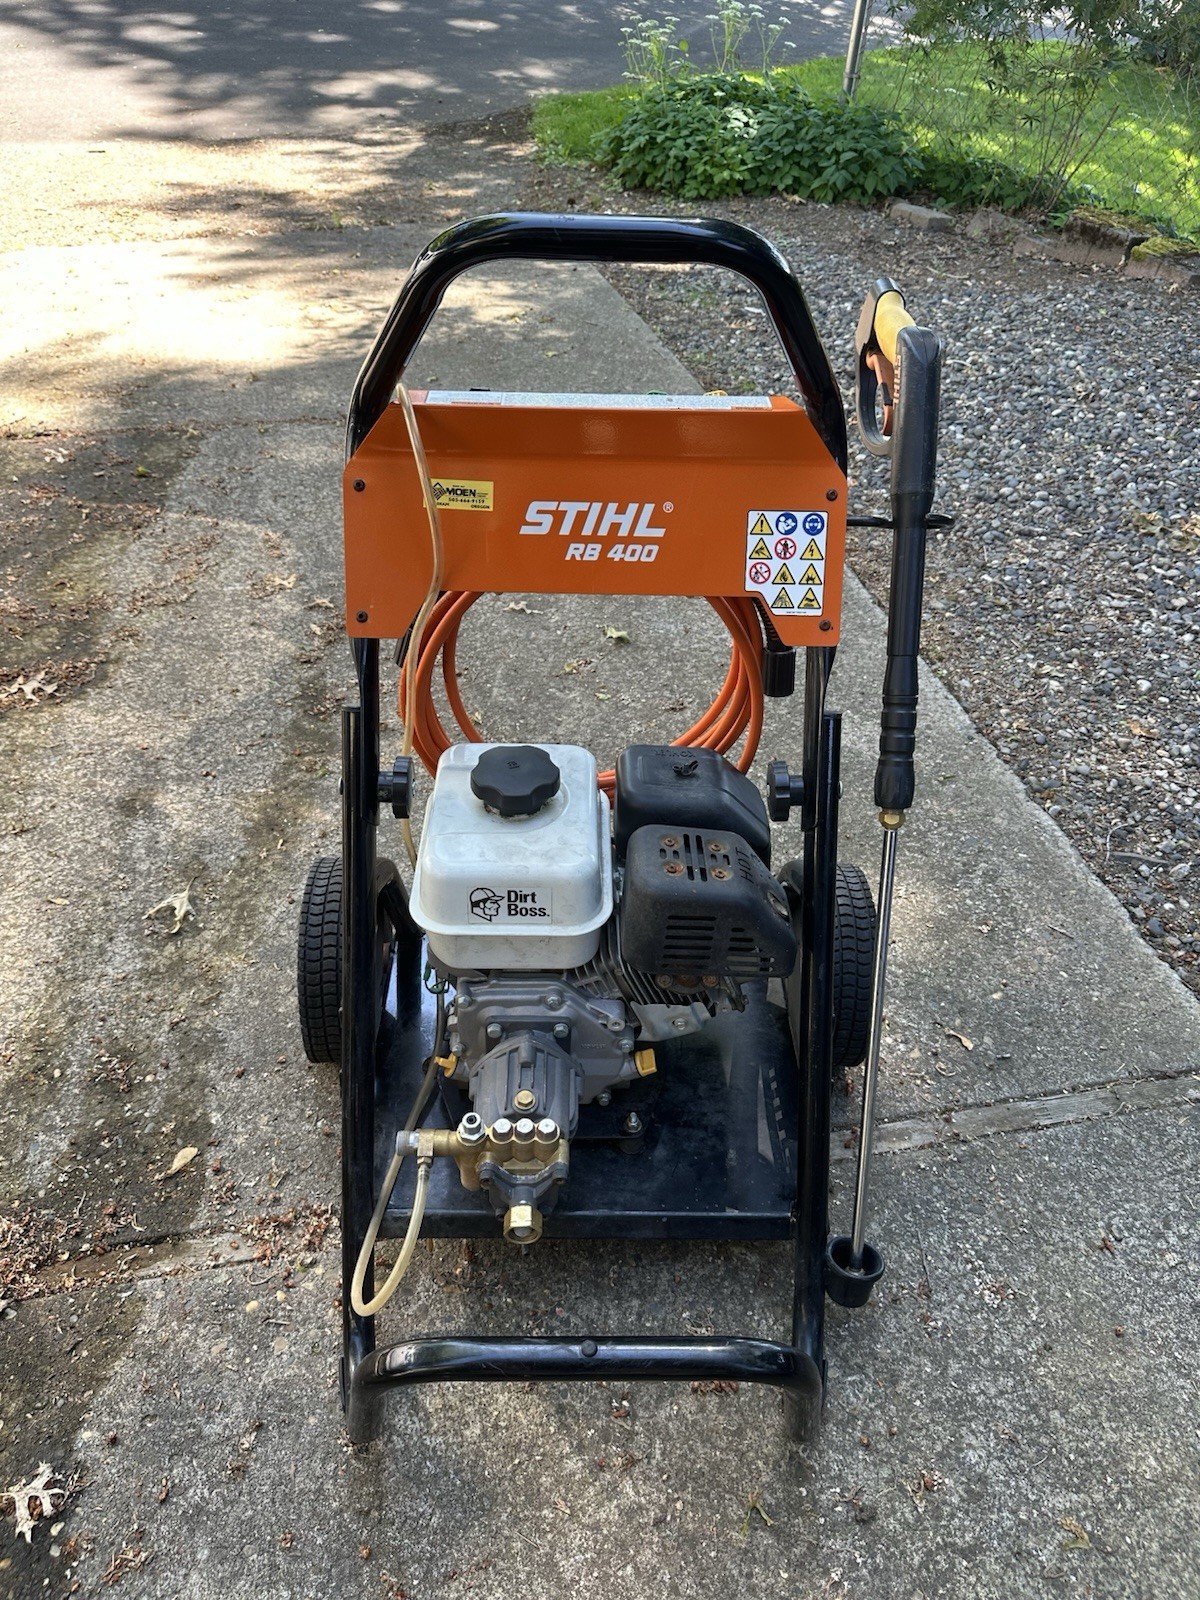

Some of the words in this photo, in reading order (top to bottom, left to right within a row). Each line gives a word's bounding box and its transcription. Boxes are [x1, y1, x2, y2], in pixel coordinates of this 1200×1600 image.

[446, 487, 476, 497] MOEN
[565, 543, 602, 561] RB
[606, 544, 659, 562] 400
[735, 847, 754, 883] HOT
[507, 890, 537, 903] Dirt
[507, 904, 550, 917] Boss.
